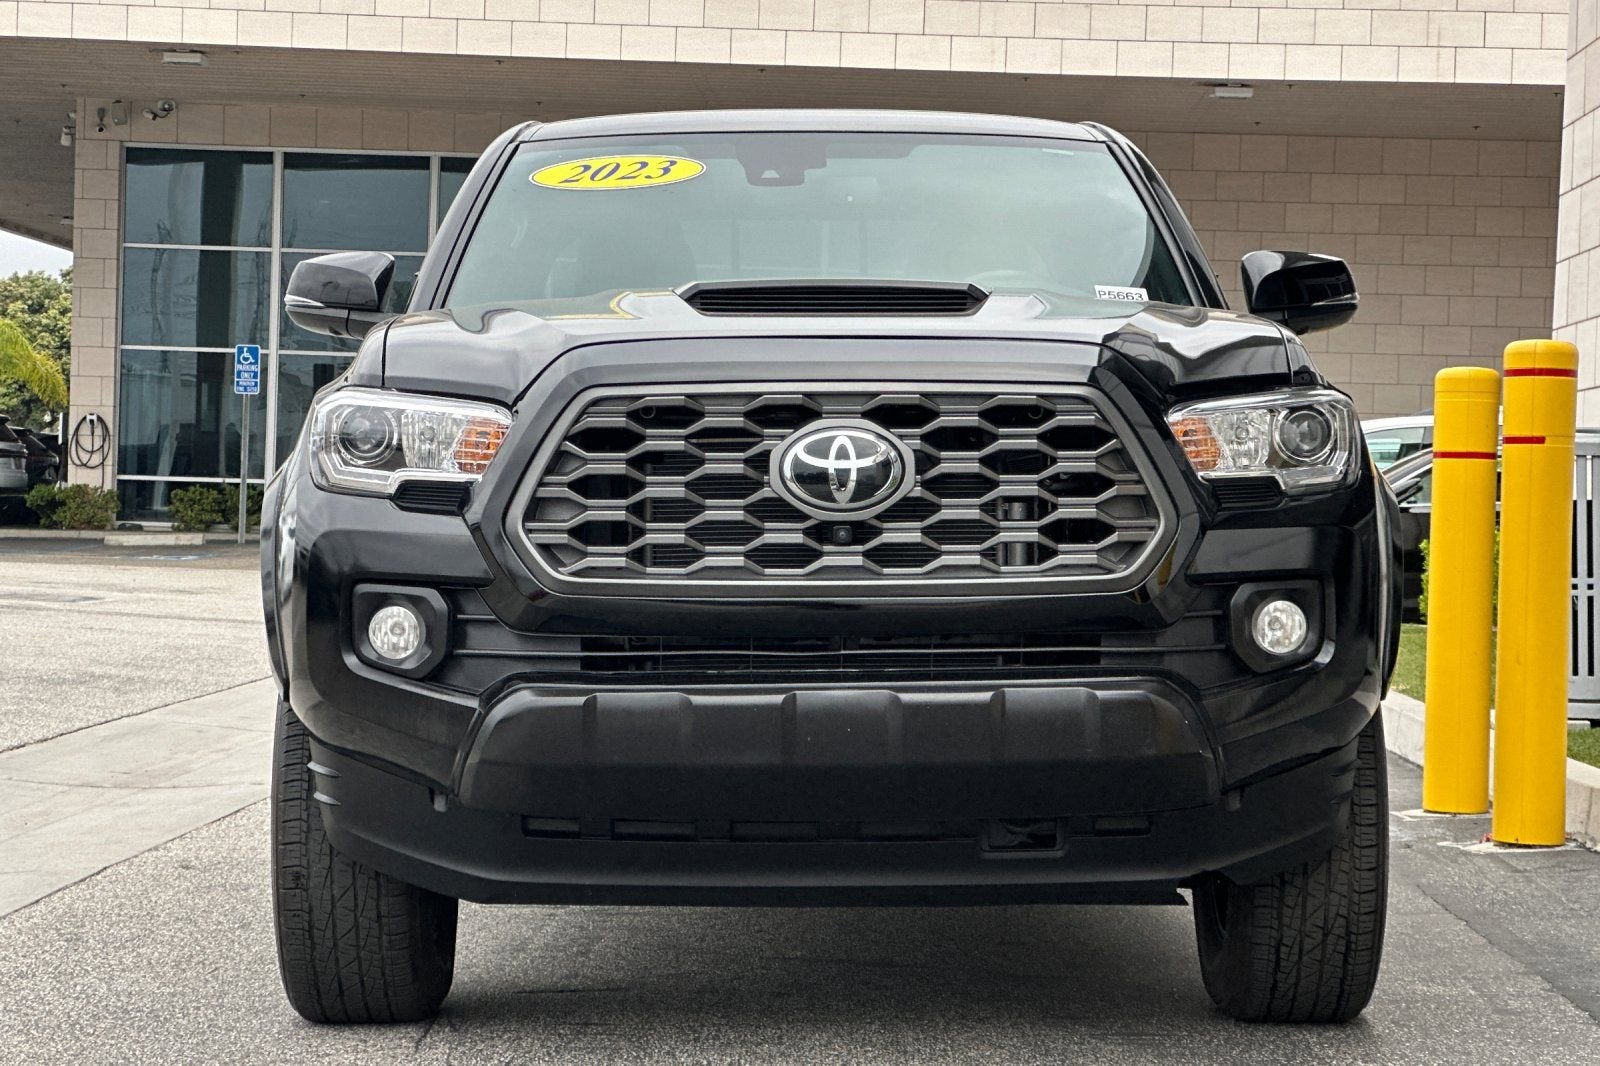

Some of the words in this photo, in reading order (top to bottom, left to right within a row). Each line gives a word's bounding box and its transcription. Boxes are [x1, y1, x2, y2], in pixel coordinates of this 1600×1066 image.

[558, 159, 678, 184] 2023
[1098, 290, 1144, 301] P5663
[237, 364, 258, 372] PARKING
[240, 371, 254, 379] ONLY
